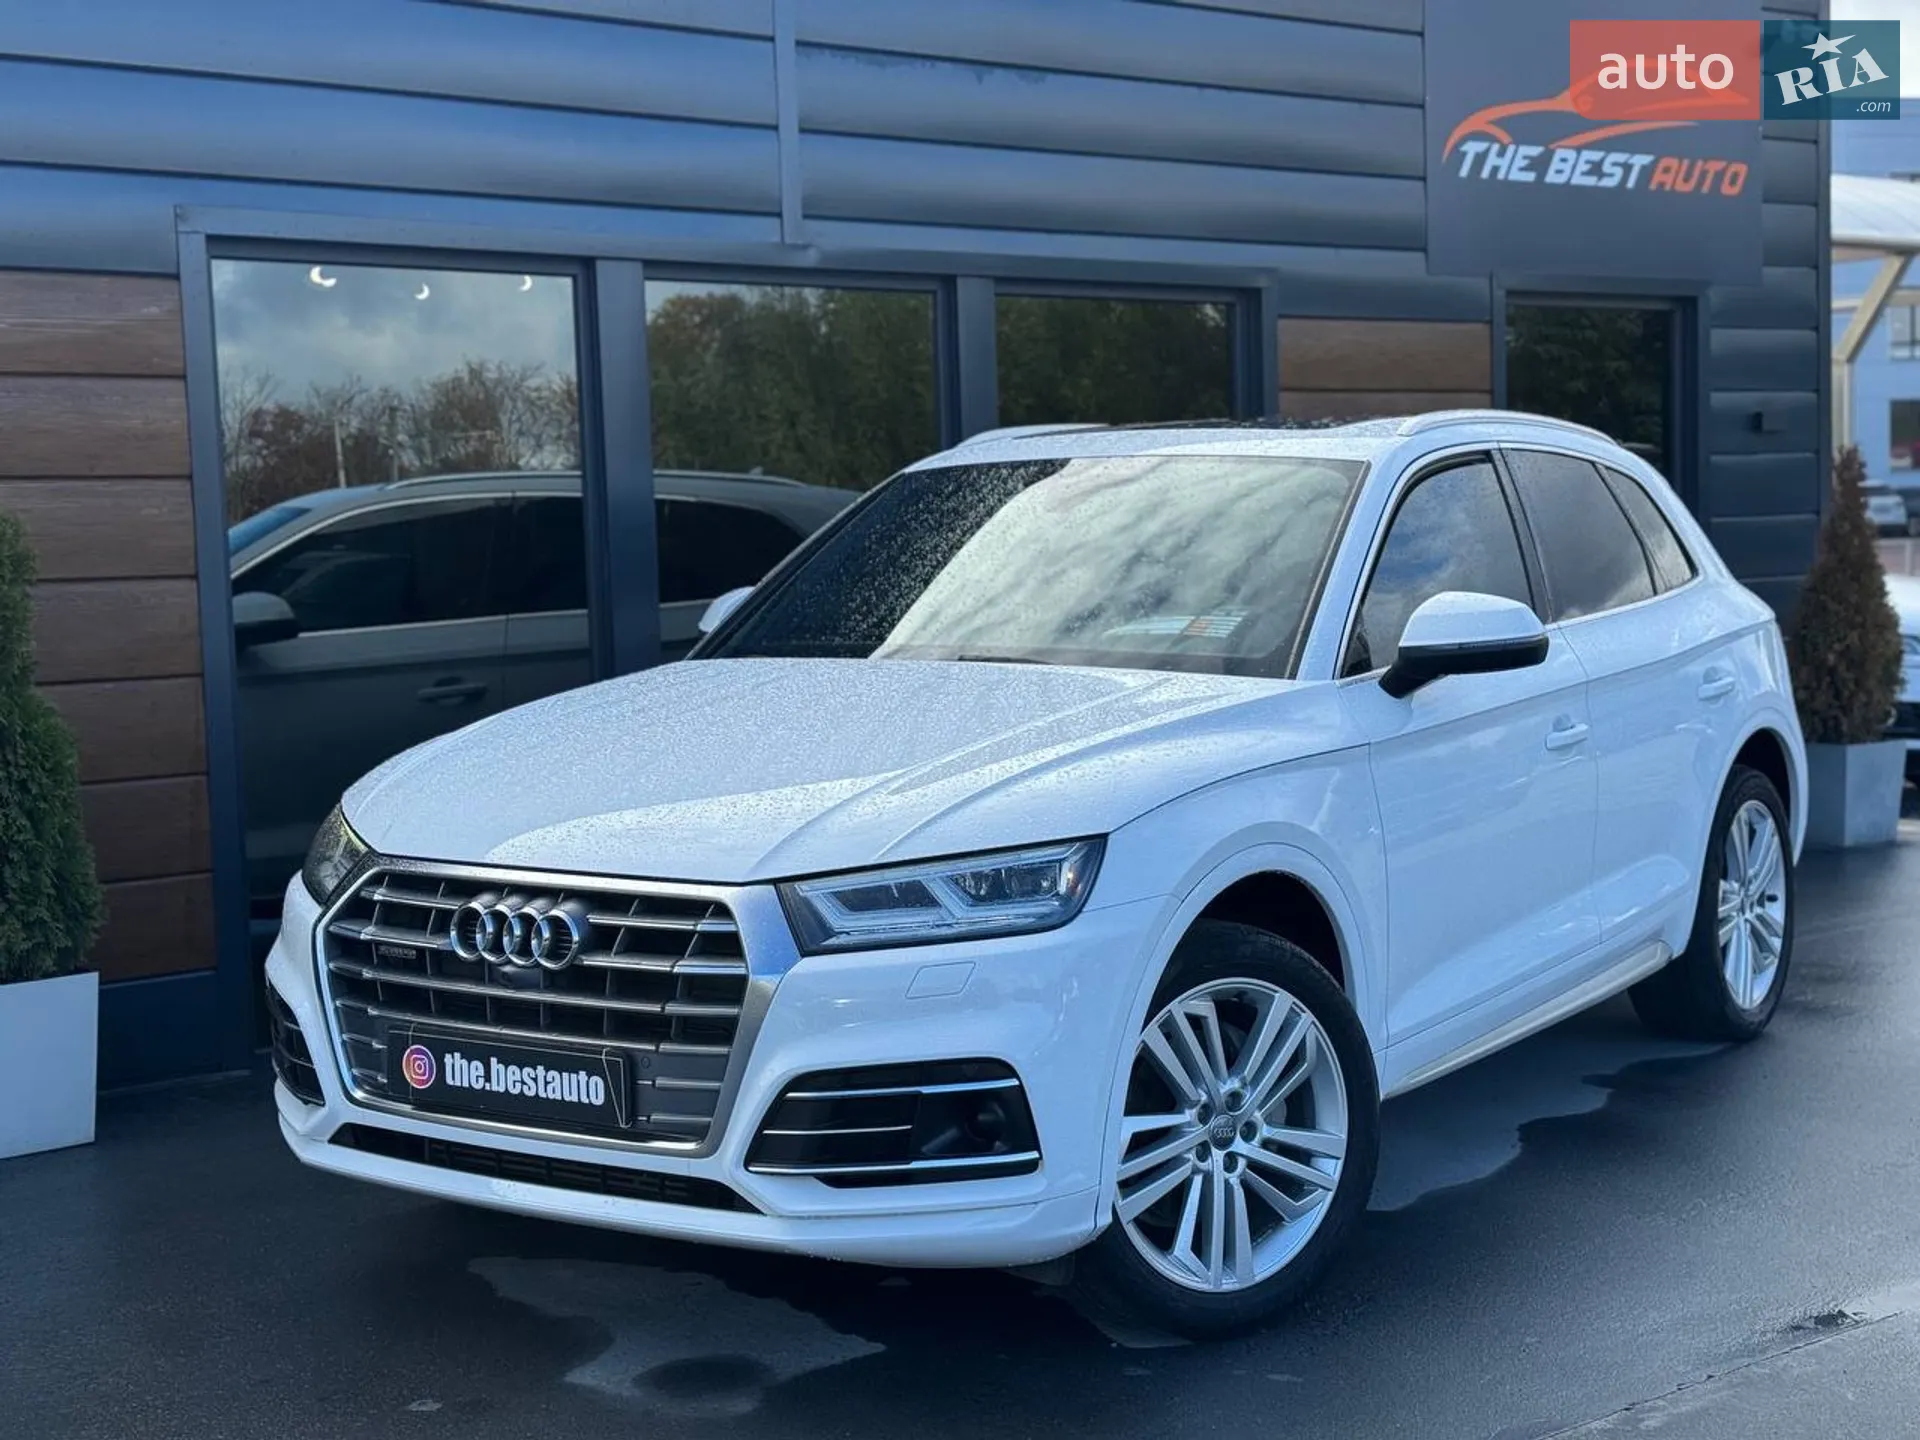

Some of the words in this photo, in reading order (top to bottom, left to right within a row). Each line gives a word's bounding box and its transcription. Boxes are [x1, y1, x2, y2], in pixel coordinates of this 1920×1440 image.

[1459, 140, 1545, 182] THE
[1544, 148, 1655, 189] BEST
[1649, 156, 1748, 196] AUTO
[443, 1052, 606, 1106] the.bestauto
